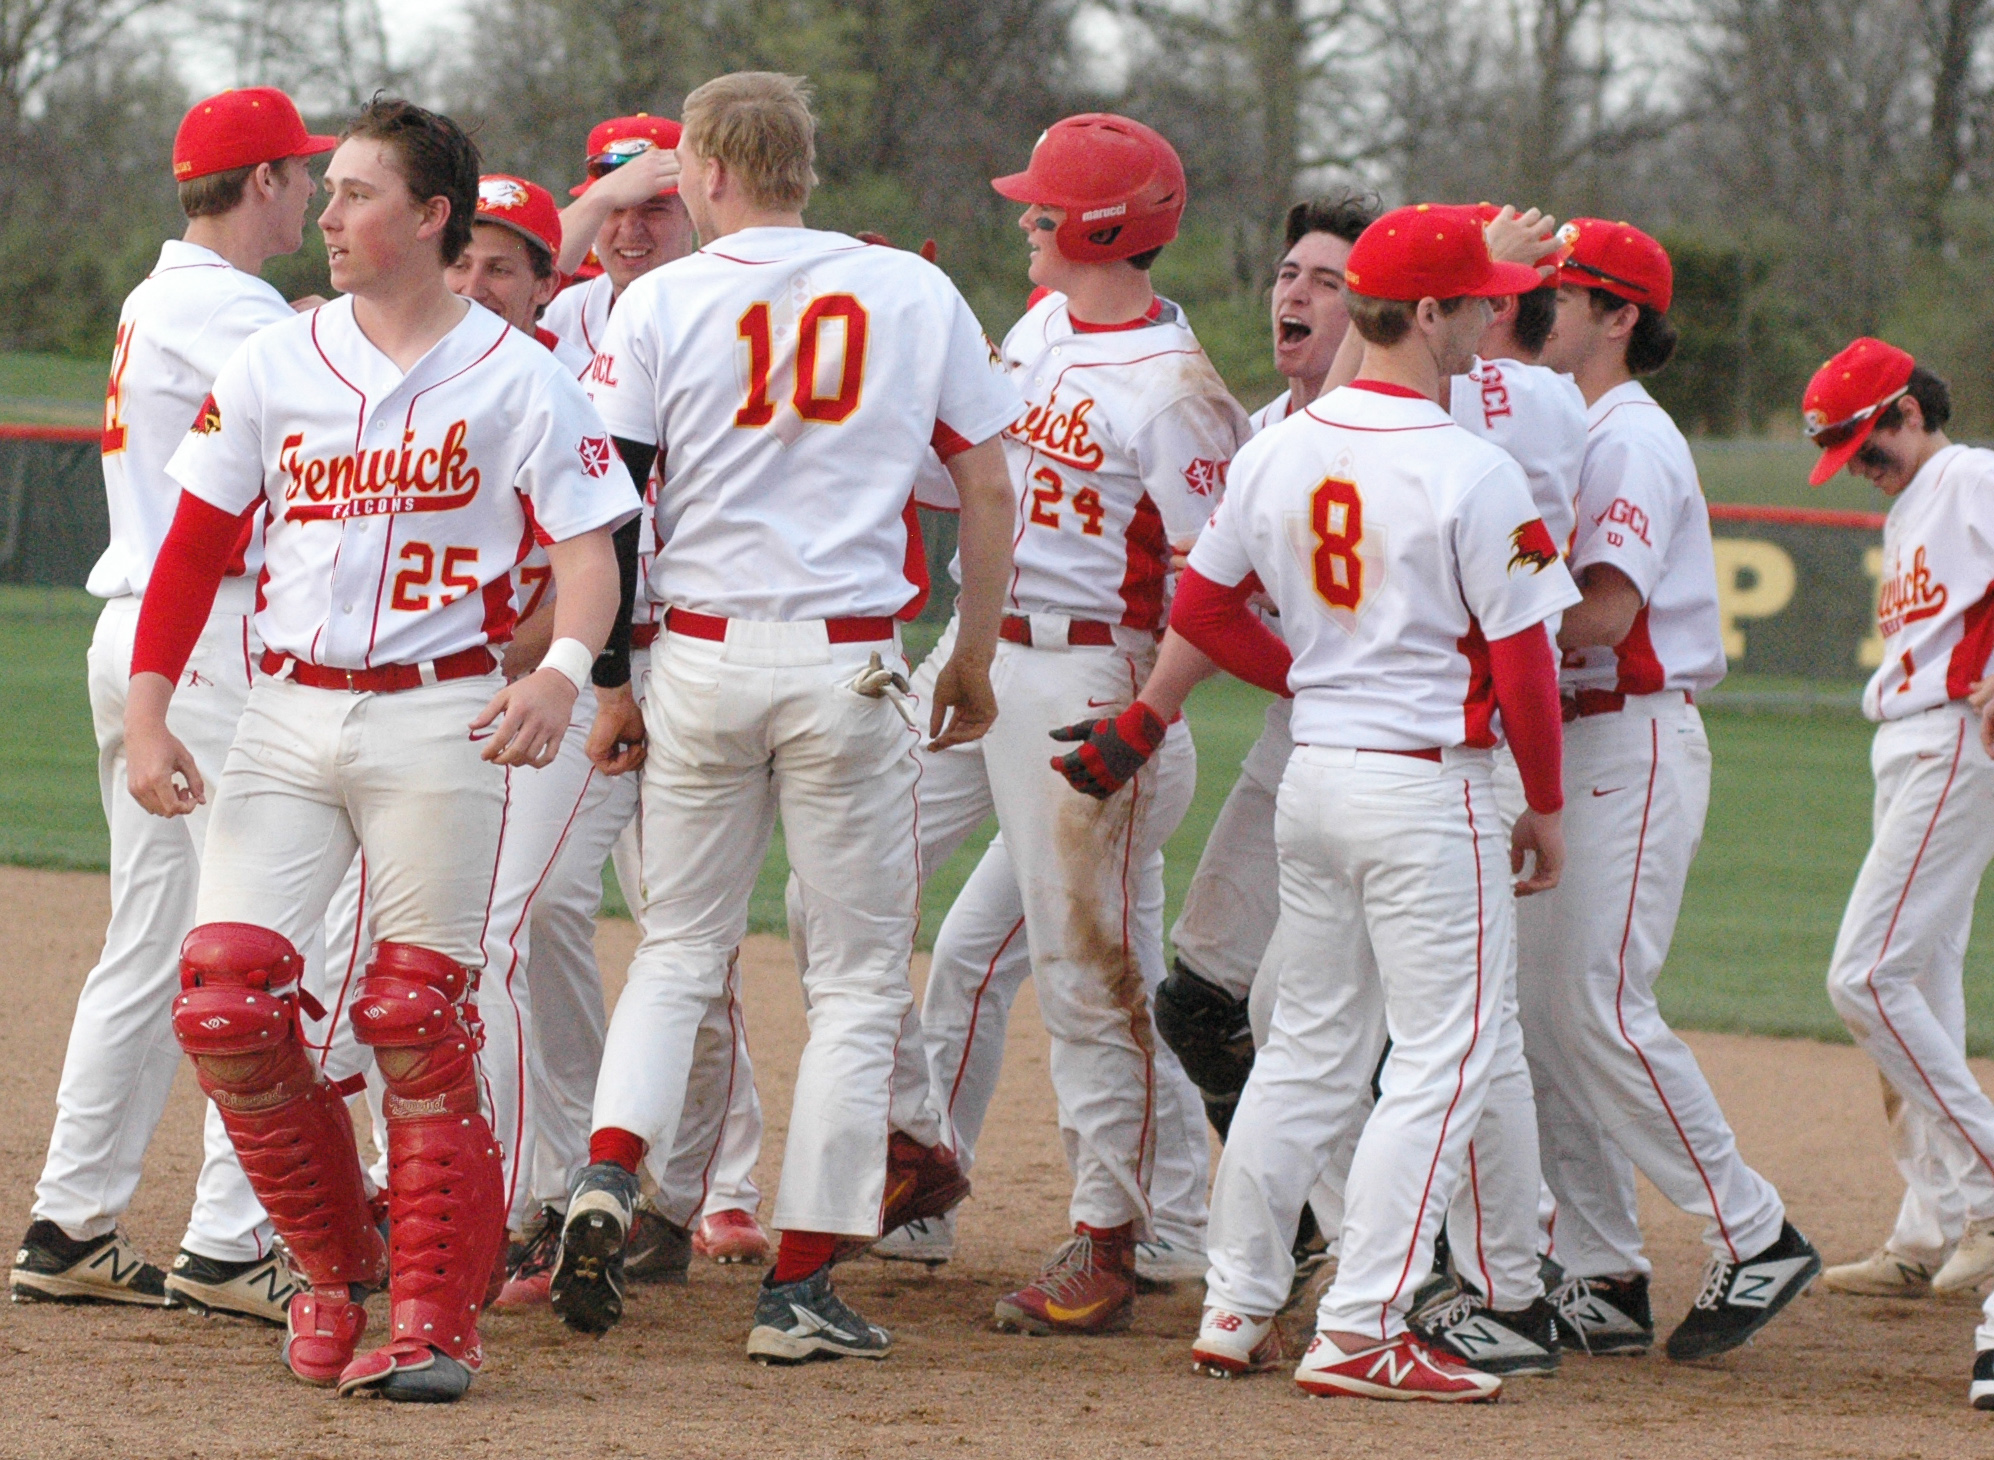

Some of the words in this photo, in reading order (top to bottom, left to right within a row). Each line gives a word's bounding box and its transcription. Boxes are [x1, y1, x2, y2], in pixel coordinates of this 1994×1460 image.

[734, 291, 871, 429] 10
[279, 418, 481, 504] Fenwick
[332, 498, 415, 519] FALCONS
[1029, 466, 1105, 537] 24
[1609, 498, 1652, 548] GCL
[1309, 475, 1365, 615] 8
[390, 540, 480, 611] 25
[89, 1246, 140, 1282] N
[247, 1265, 294, 1302] N
[1452, 1322, 1500, 1354] N
[1366, 1349, 1416, 1387] N
